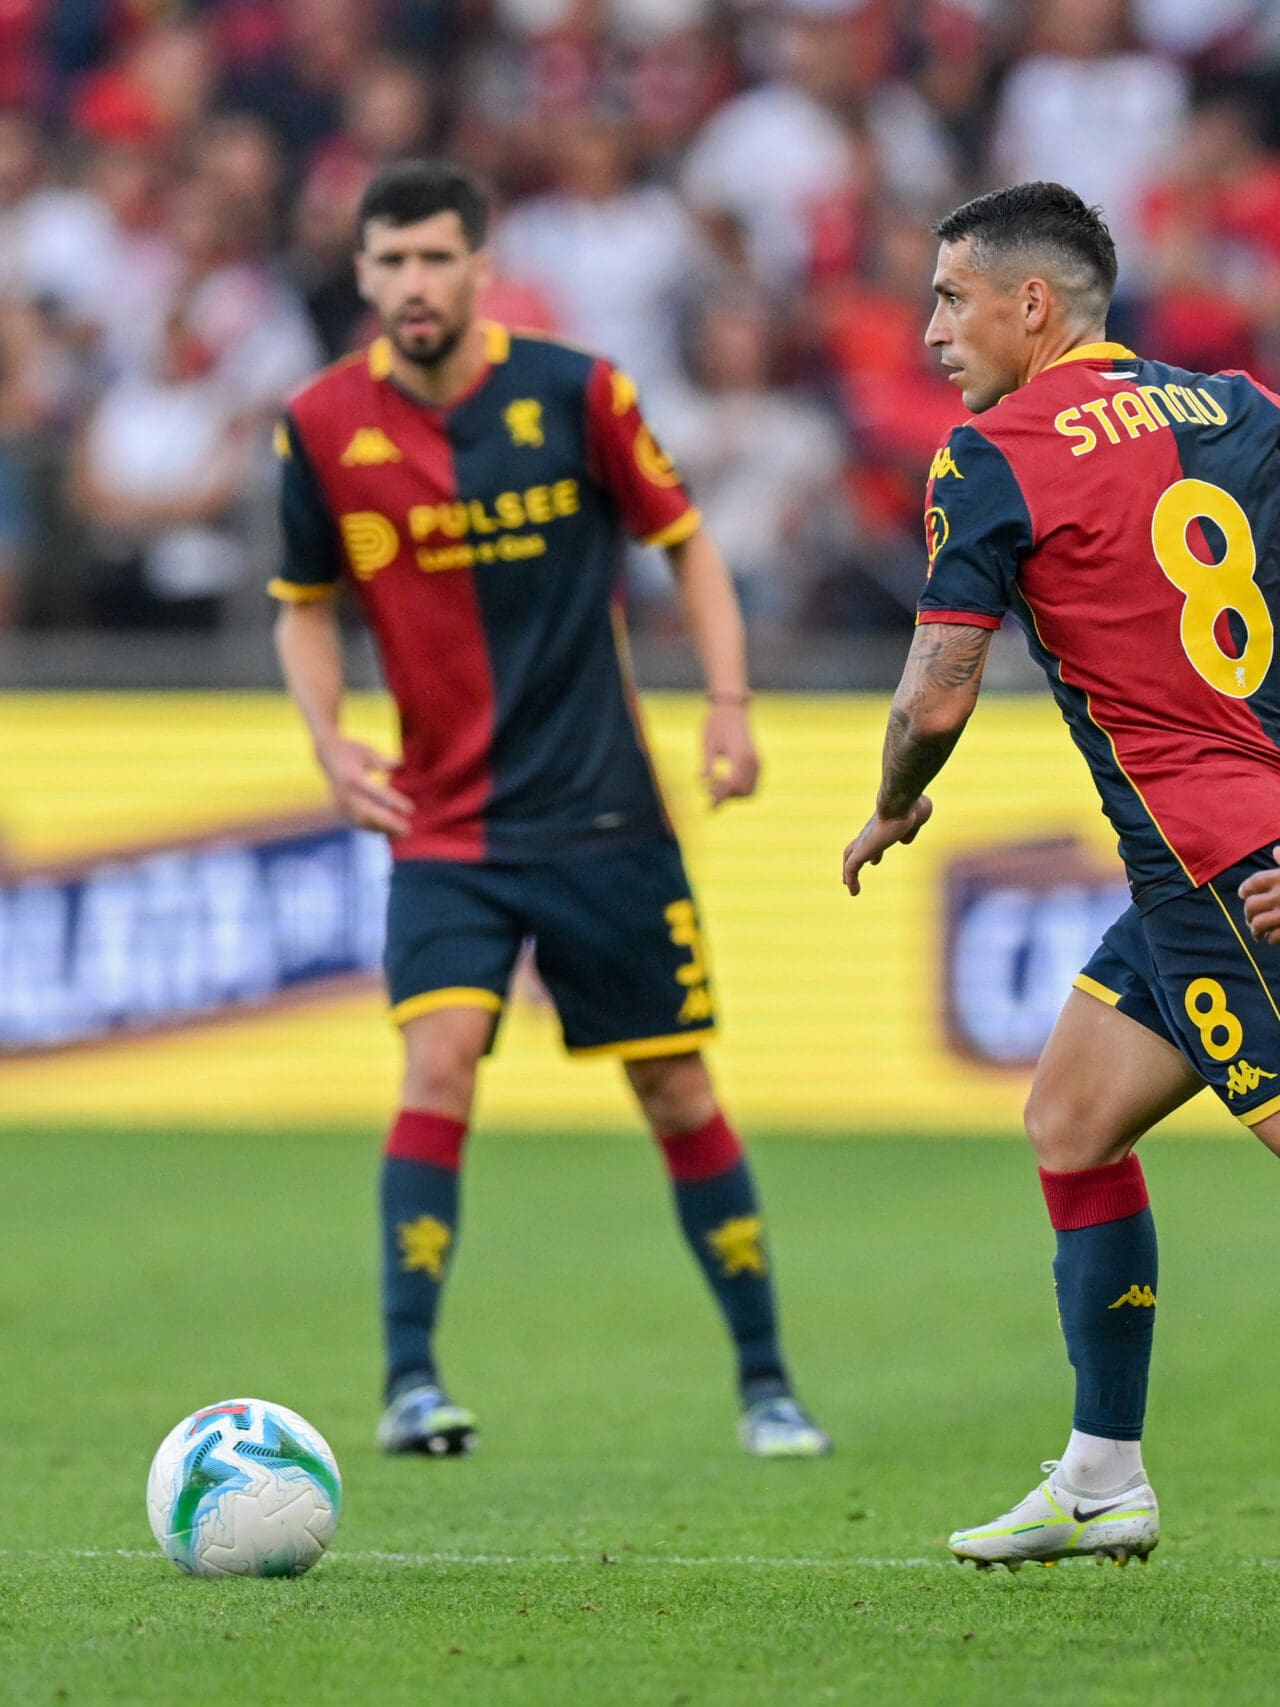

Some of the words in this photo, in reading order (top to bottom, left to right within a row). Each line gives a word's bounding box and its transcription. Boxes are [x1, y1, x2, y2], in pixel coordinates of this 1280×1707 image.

[408, 478, 580, 542] PULSEE
[1151, 478, 1274, 699] 8
[1184, 977, 1243, 1061] 8
